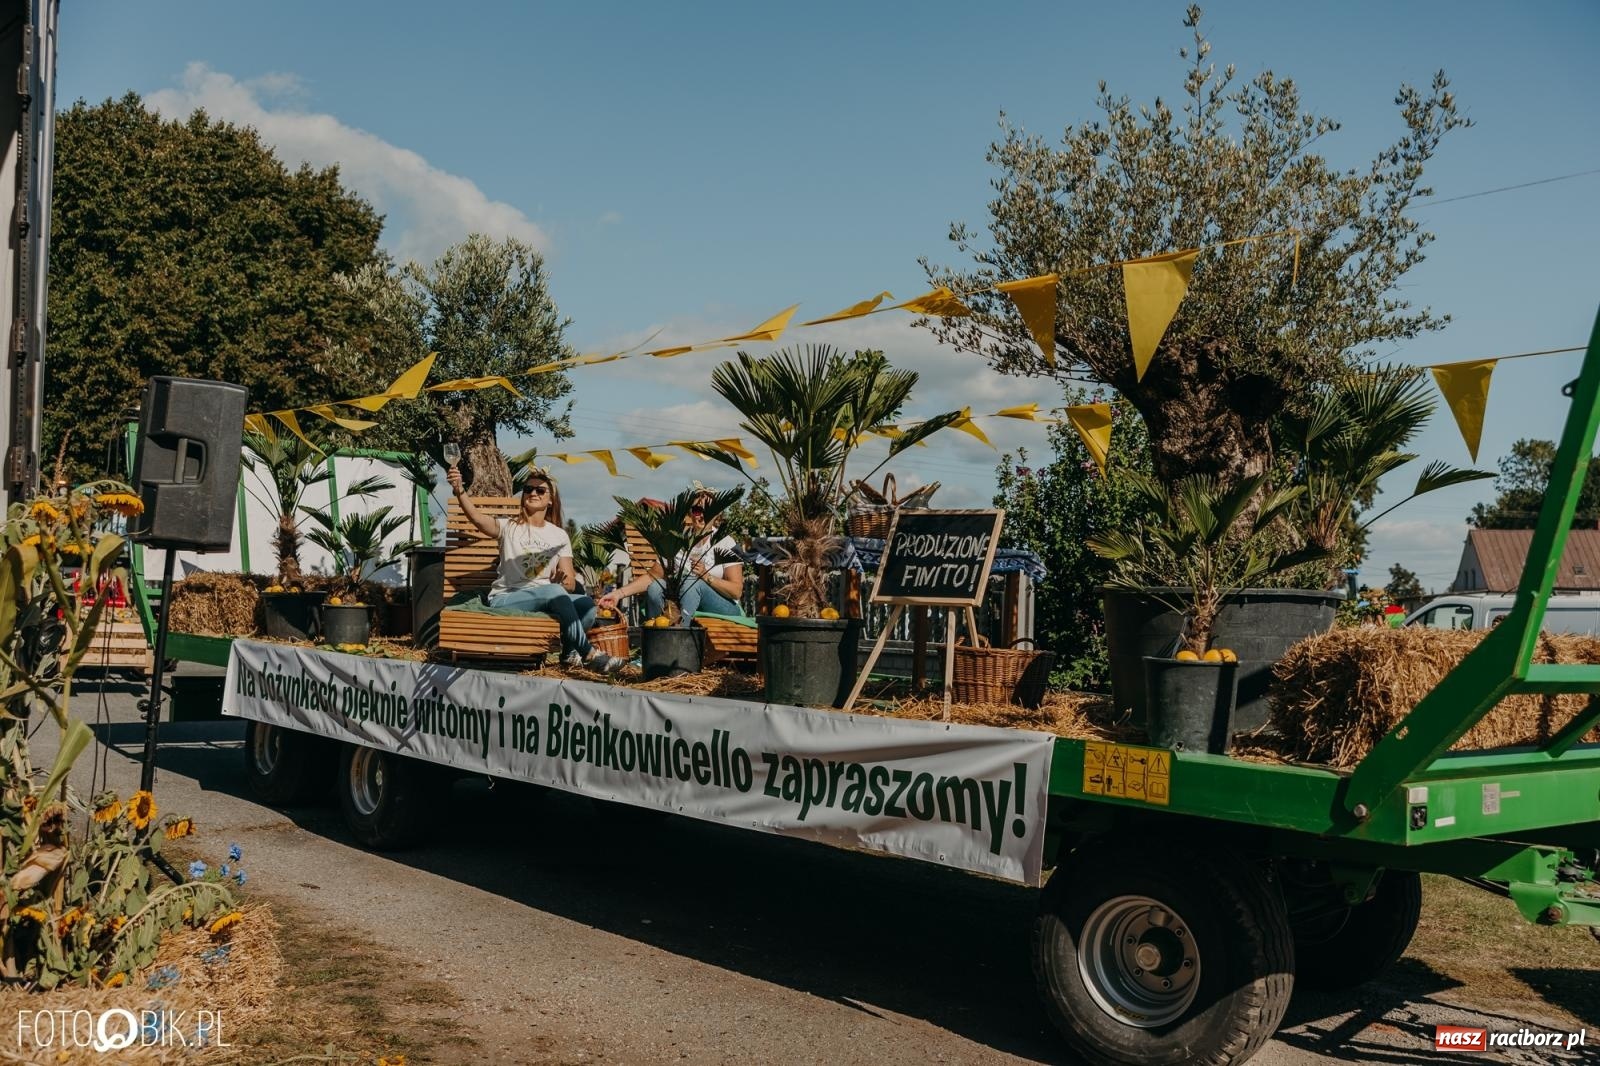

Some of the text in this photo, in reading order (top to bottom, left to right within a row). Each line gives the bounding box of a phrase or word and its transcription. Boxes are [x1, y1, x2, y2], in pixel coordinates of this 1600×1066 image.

[895, 531, 991, 561] PRODUZIONE
[900, 563, 980, 592] FINITO!
[236, 658, 1028, 856] Na dożynkach pięknie witomy i na Bieńkowicello zapraszomy!
